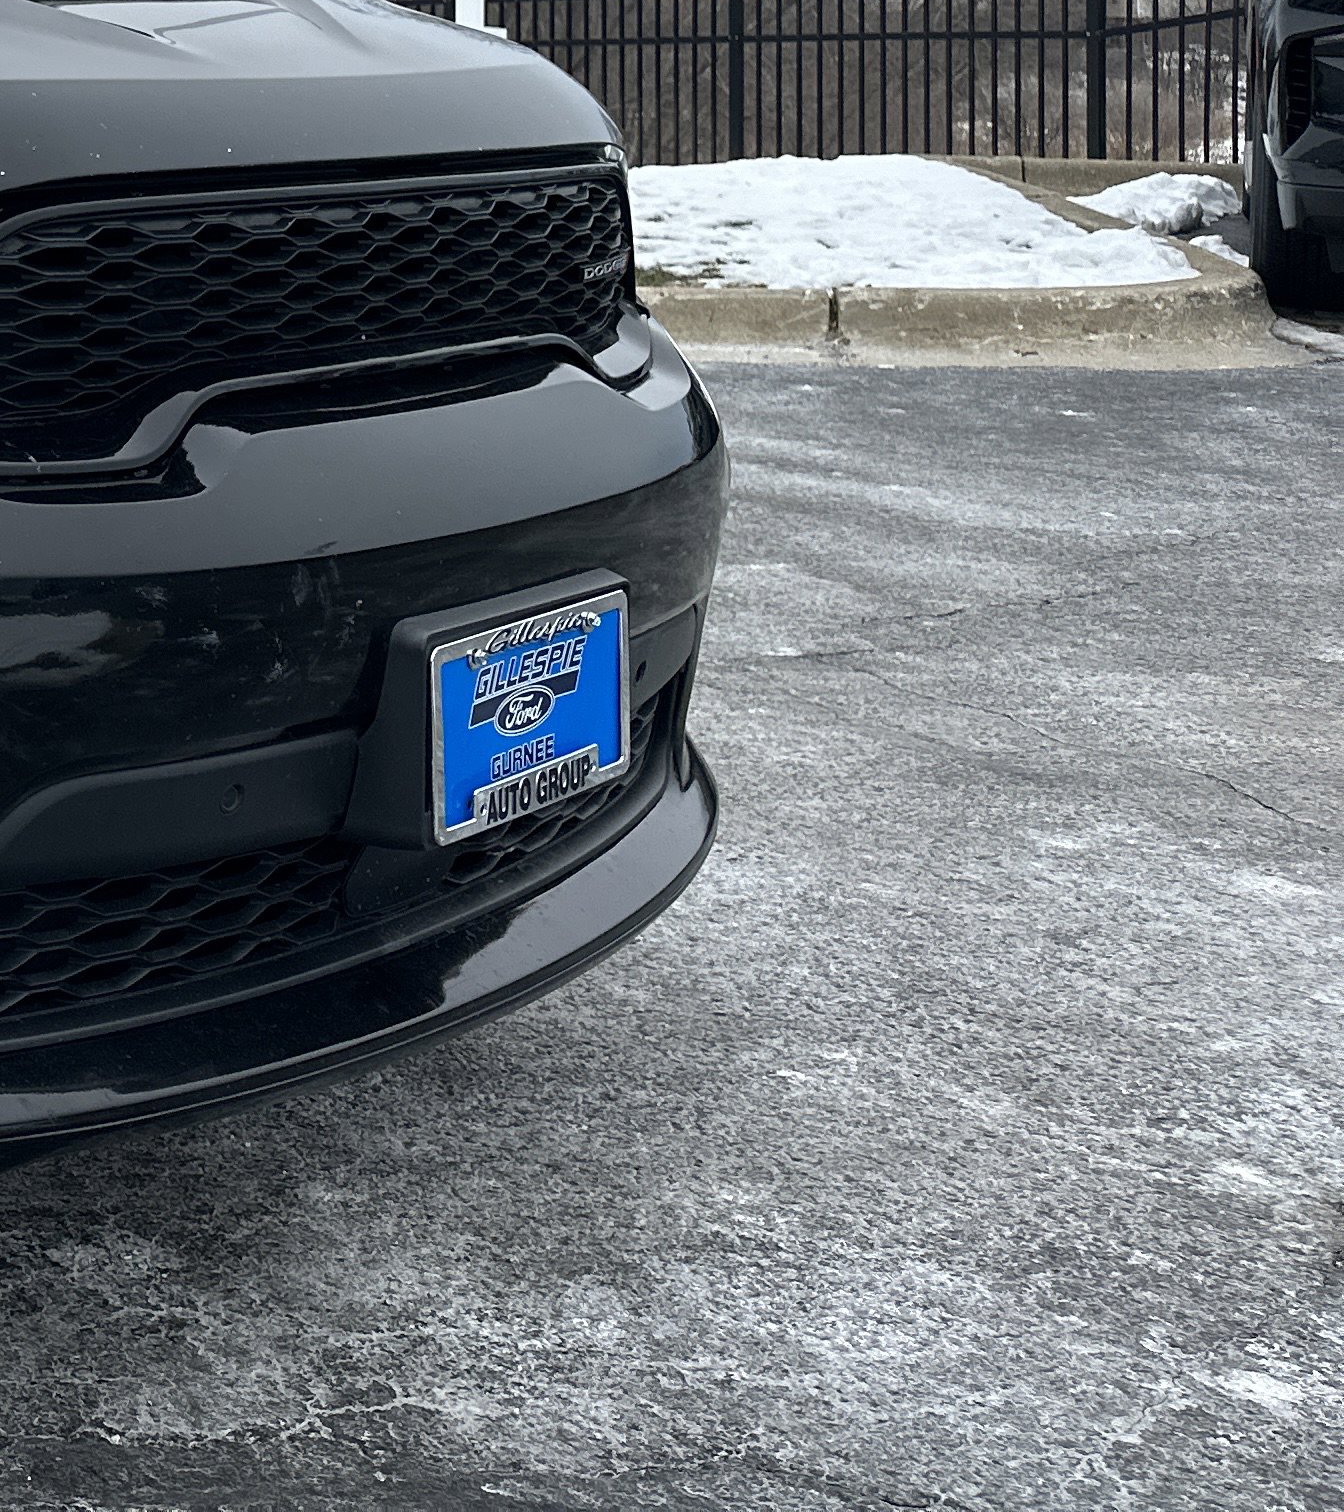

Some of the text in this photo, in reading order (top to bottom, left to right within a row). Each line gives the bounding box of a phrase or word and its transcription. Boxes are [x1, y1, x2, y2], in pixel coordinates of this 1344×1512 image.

[474, 635, 587, 701] GILLESPIE
[505, 695, 544, 730] Ford
[490, 733, 555, 781] GURNEE
[486, 753, 592, 826] AUTO GROUP
